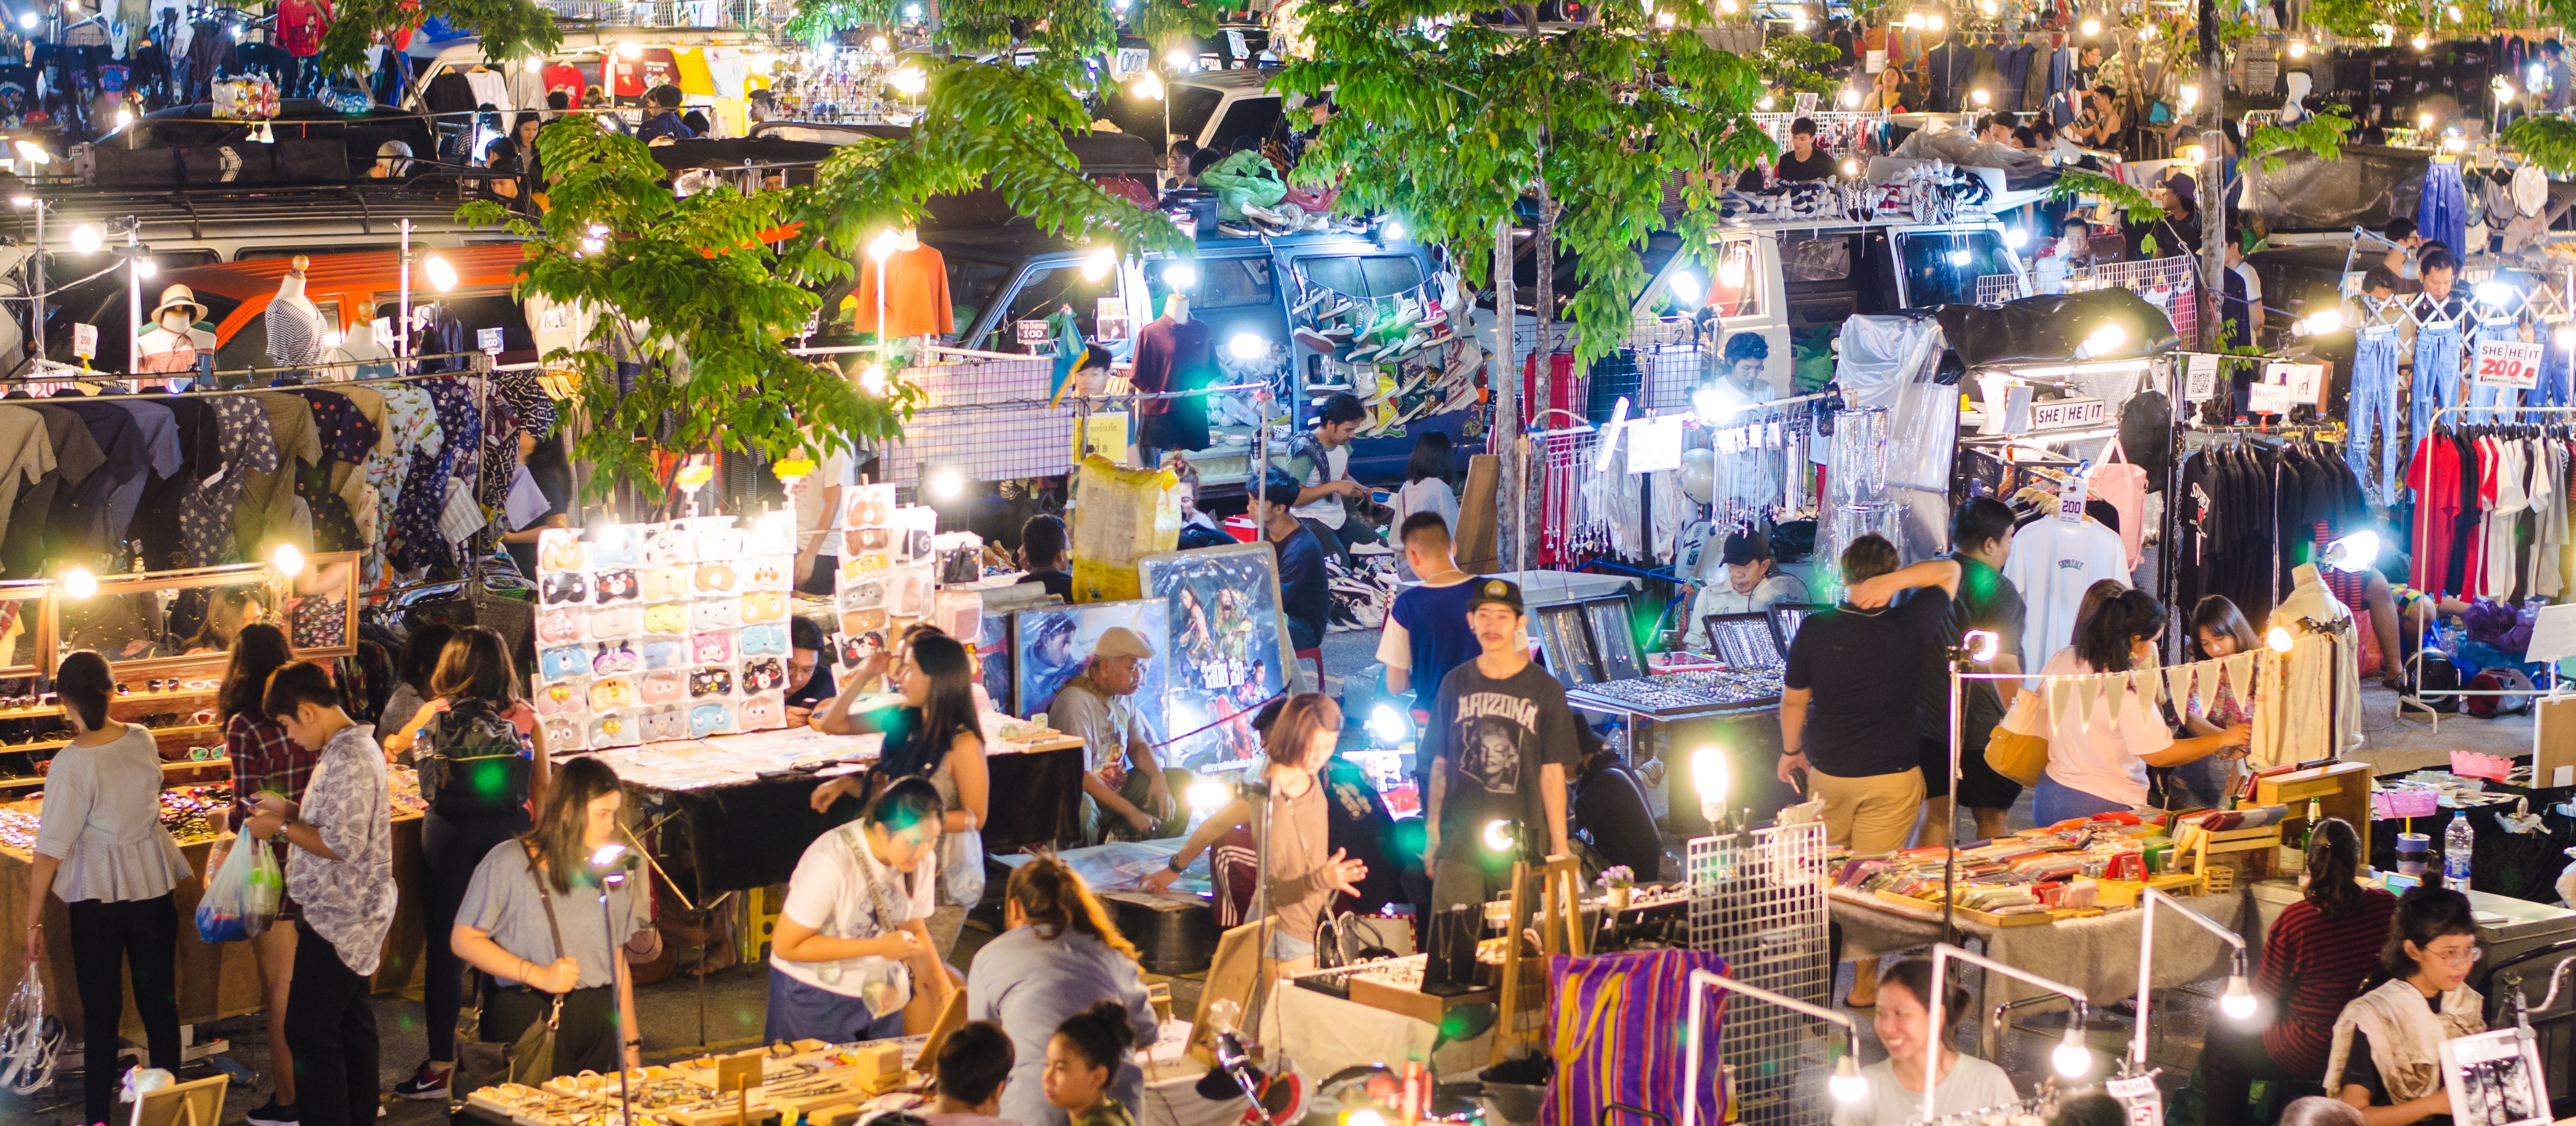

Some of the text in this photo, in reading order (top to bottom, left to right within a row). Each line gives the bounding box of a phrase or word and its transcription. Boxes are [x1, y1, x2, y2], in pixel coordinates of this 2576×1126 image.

[1024, 330, 1043, 338] 100
[80, 335, 90, 346] 250
[484, 339, 498, 347] 200
[2479, 358, 2522, 377] 200
[2267, 400, 2288, 411] 300
[2038, 408, 2060, 423] SHE
[2091, 404, 2102, 418] IT
[2062, 500, 2081, 514] 200
[1454, 692, 1539, 734] ARIZONA
